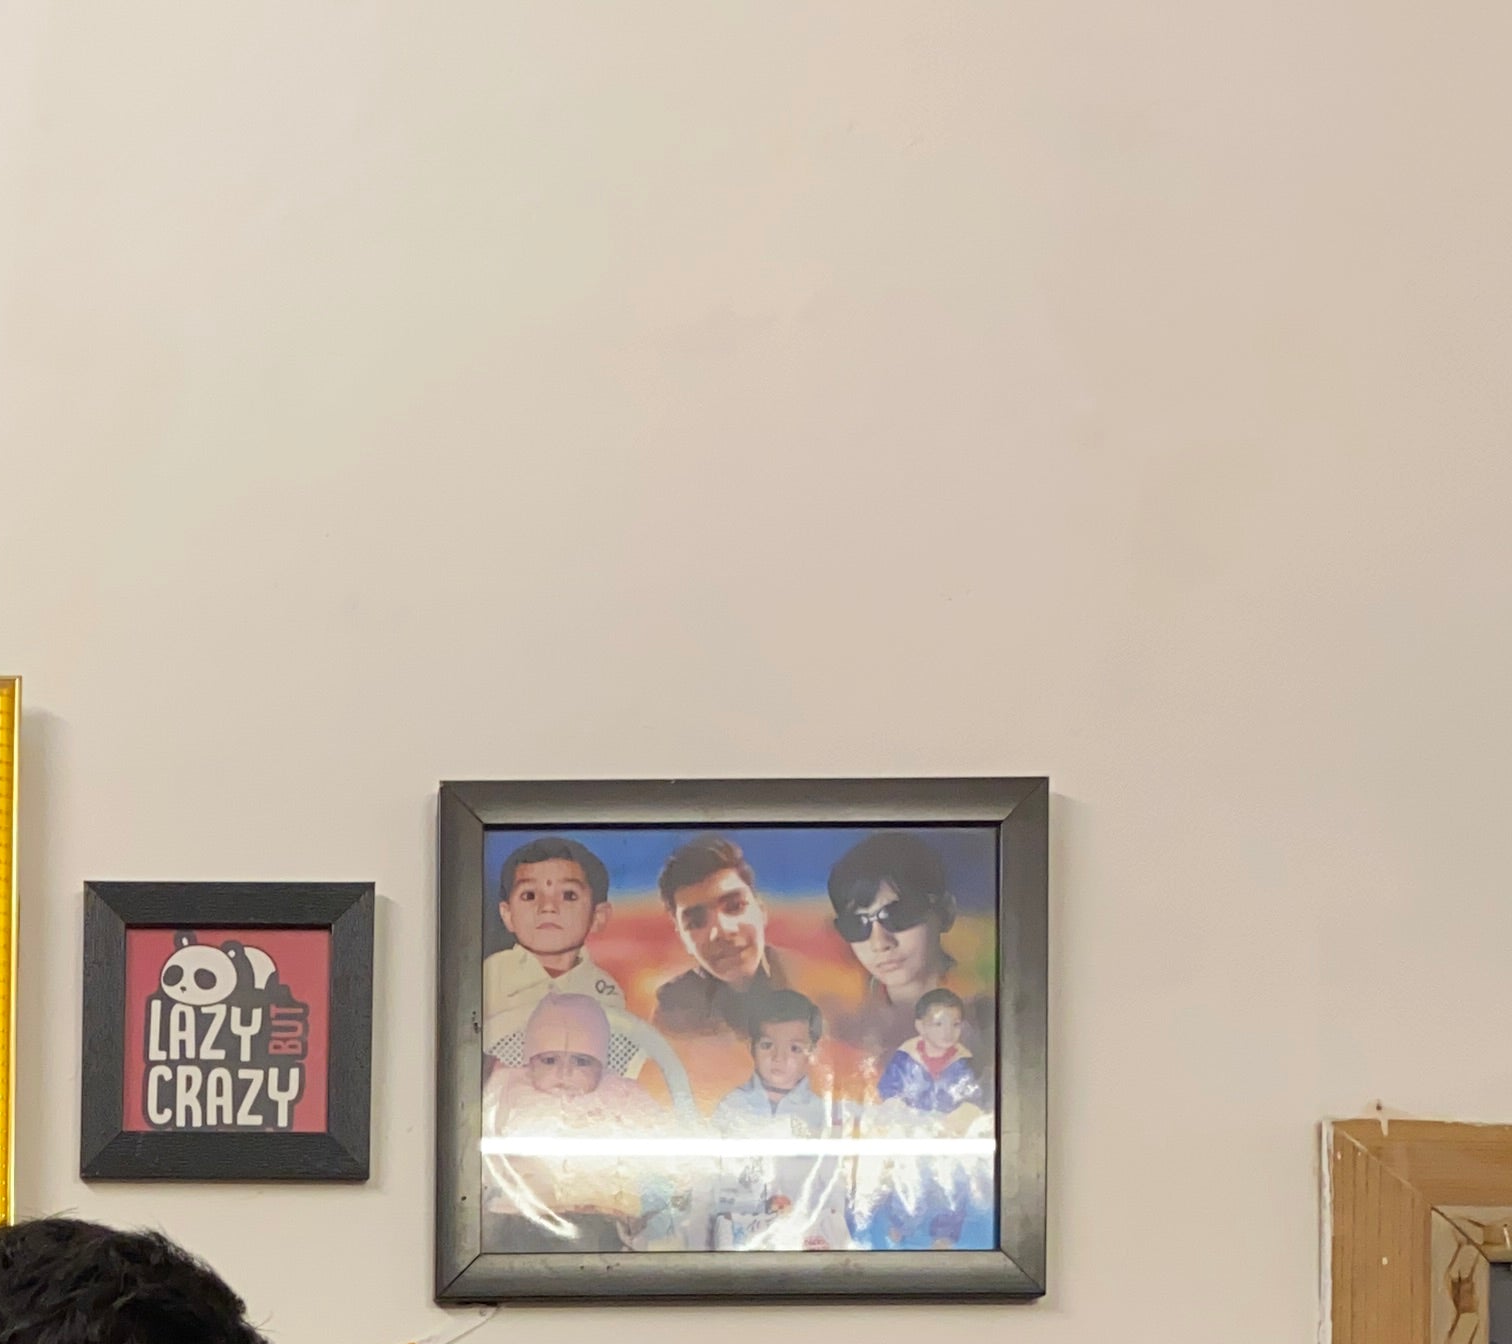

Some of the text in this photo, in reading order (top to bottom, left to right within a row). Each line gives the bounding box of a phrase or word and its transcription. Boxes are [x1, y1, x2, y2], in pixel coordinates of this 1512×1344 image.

[148, 998, 262, 1062] LAZY
[268, 1004, 304, 1055] BUT
[147, 1064, 300, 1127] CRAZY
